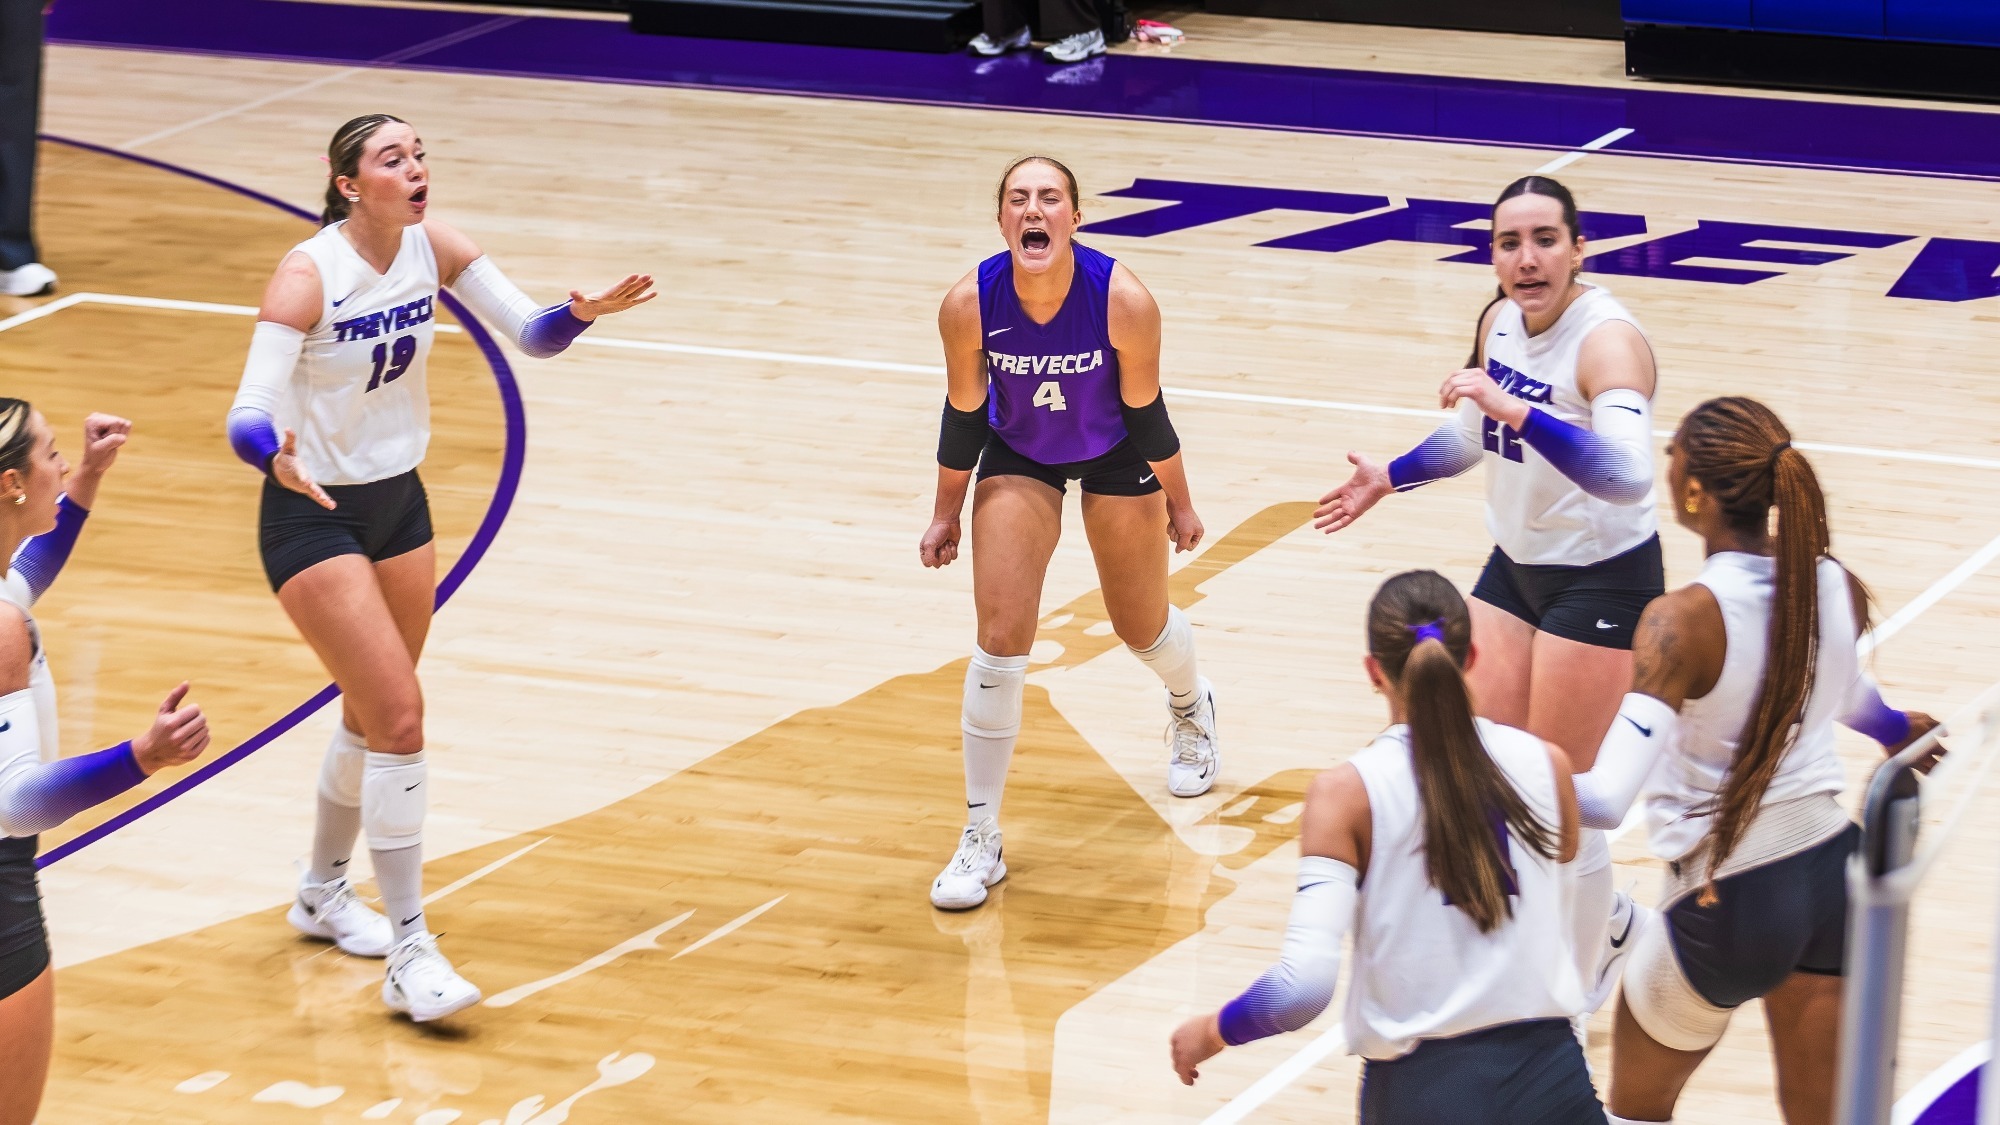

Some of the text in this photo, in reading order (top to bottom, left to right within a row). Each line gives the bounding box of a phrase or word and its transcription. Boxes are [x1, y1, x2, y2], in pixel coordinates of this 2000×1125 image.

[365, 335, 416, 393] 19
[988, 350, 1103, 374] TREVECCA
[1033, 381, 1067, 411] 4
[1482, 414, 1524, 463] 22
